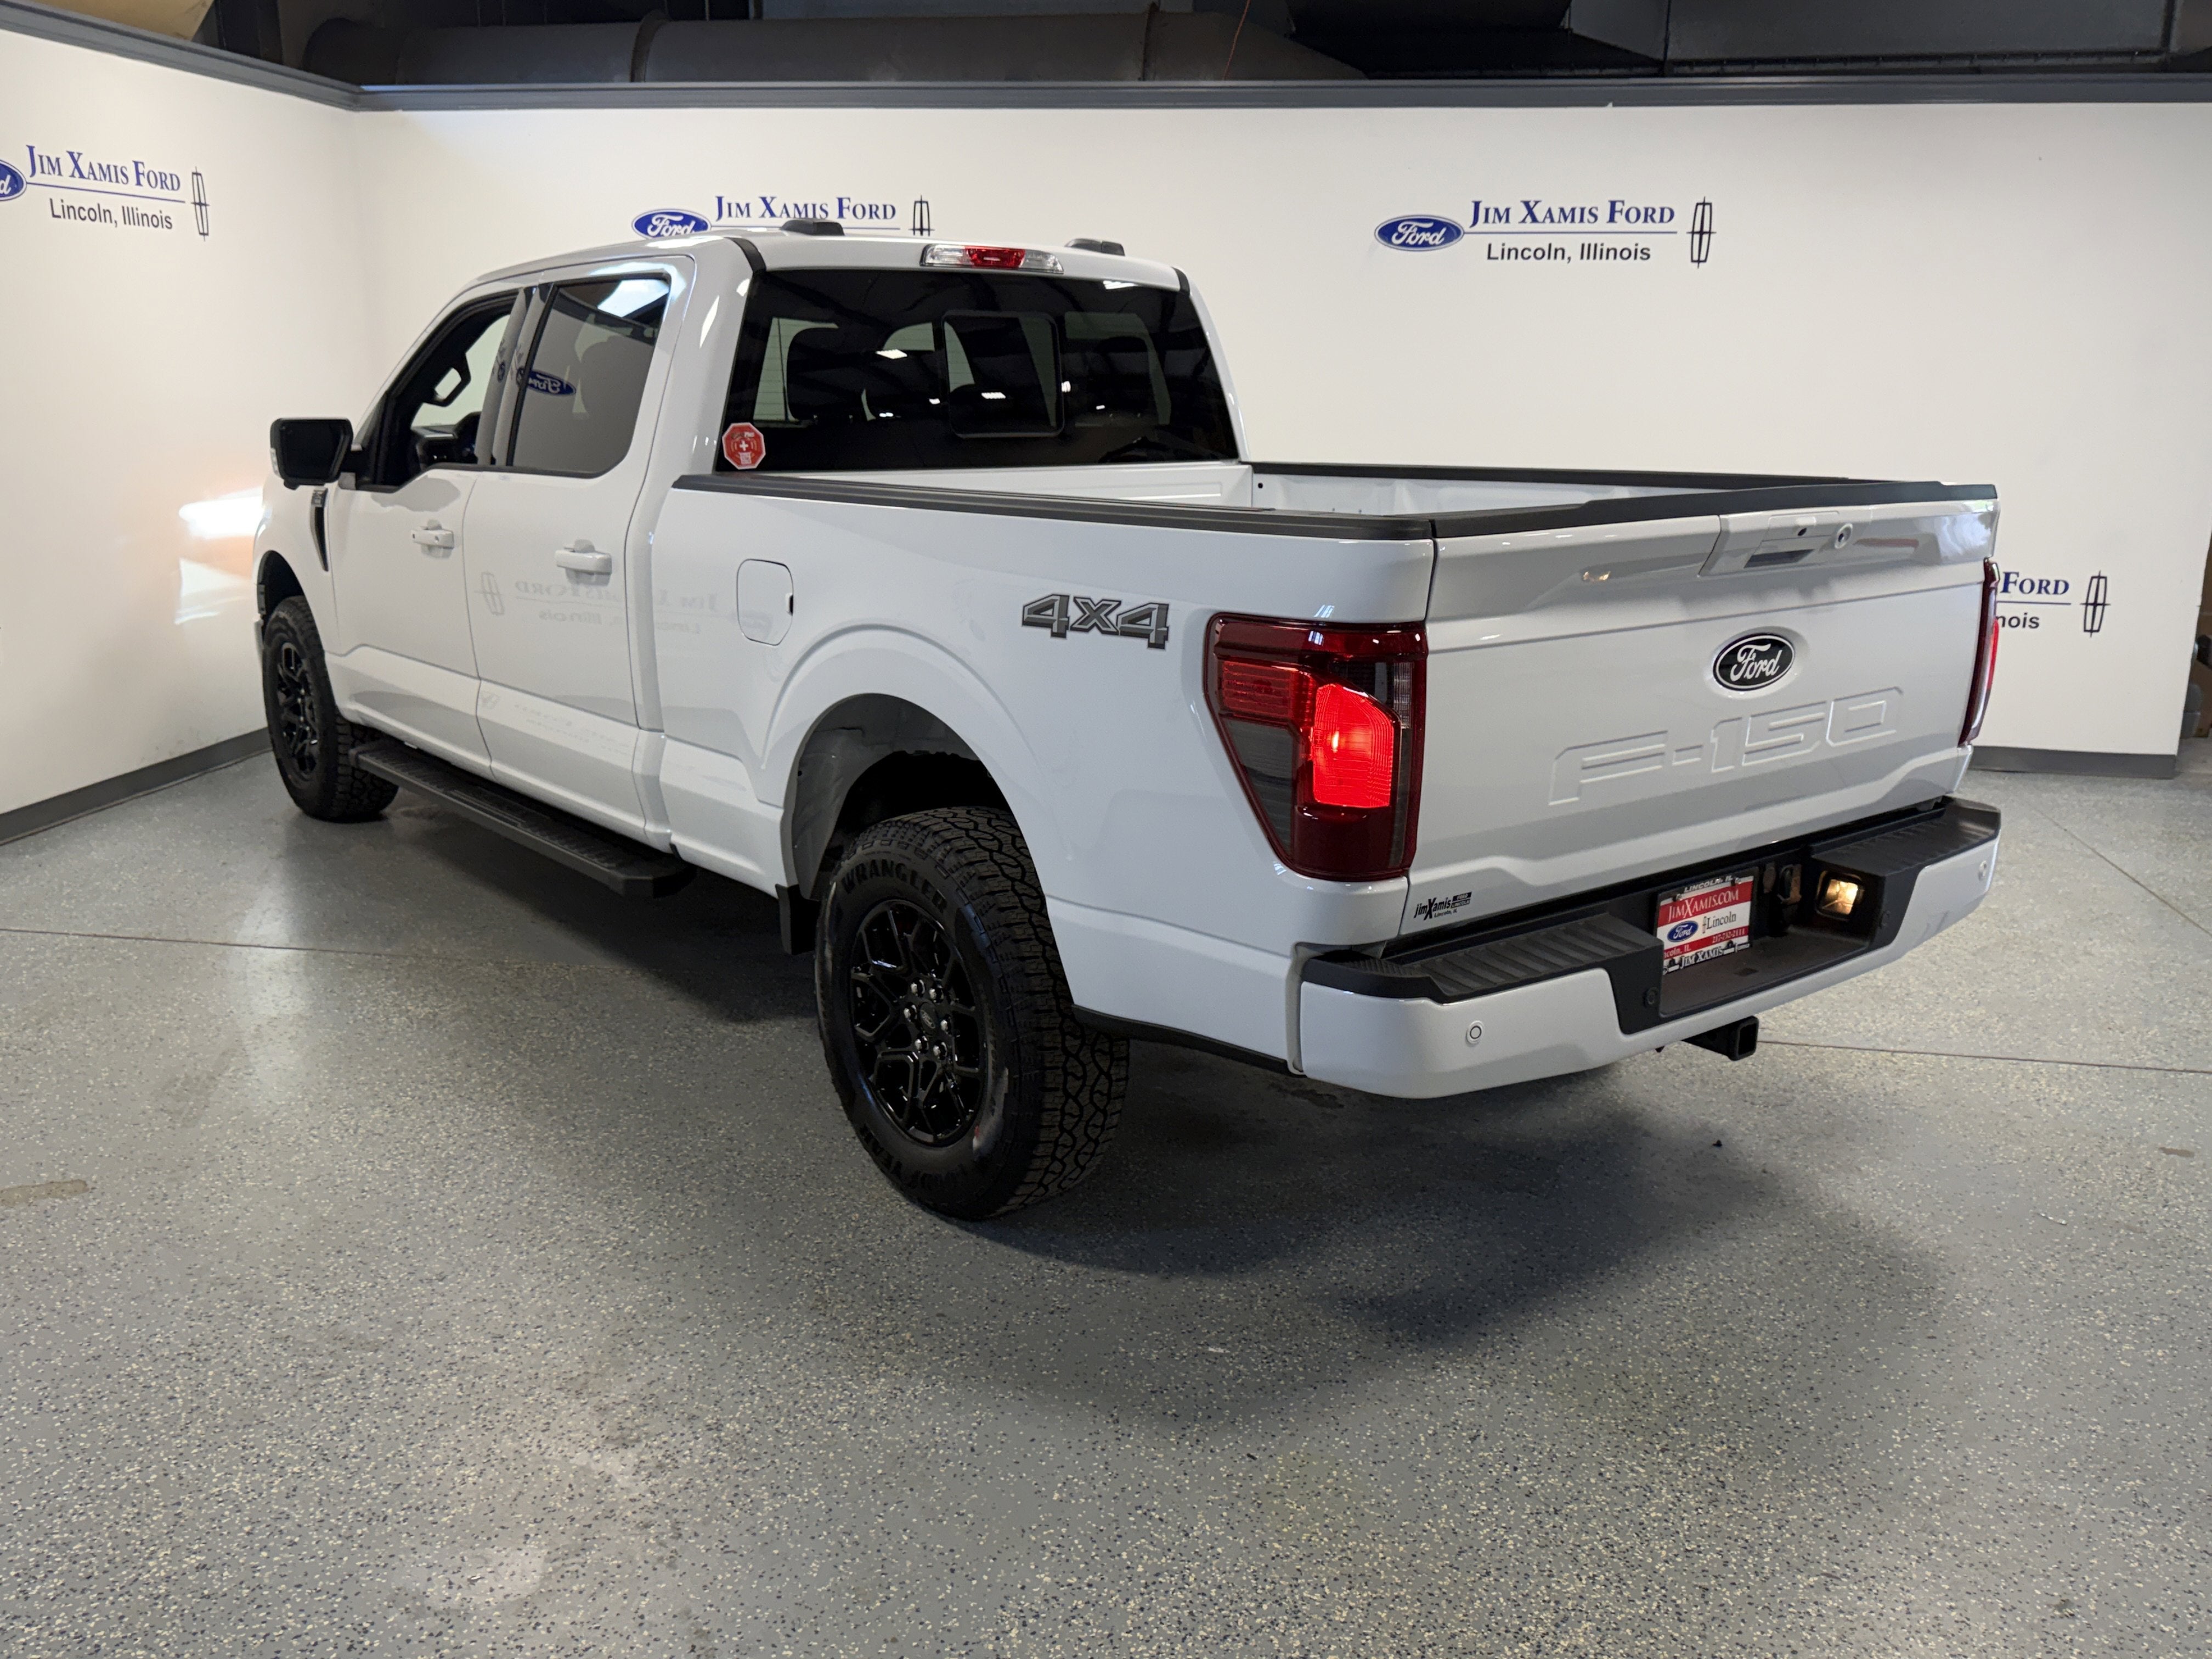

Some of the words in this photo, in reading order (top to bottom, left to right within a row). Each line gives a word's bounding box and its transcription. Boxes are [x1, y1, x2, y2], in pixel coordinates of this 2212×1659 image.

[26, 145, 63, 178] JIM
[66, 150, 129, 185] XAMIS
[132, 160, 180, 191] FORD
[49, 198, 117, 227] Lincoln,
[122, 206, 173, 229] Illinois
[715, 196, 751, 222] JIM
[758, 196, 829, 219] XAMIS
[836, 198, 896, 220] FORD
[1469, 200, 1511, 228] JIM
[1518, 200, 1599, 224] XAMIS
[1606, 200, 1675, 224] FORD
[647, 213, 695, 238] Ford
[1391, 221, 1445, 246] Ford
[1487, 242, 1572, 263] Lincoln,
[1579, 242, 1651, 261] Illinois
[2000, 571, 2070, 595] FORD
[1996, 612, 2040, 629] nois
[1730, 643, 1782, 682] Ford
[1548, 686, 1904, 805] F-150
[842, 859, 947, 913] WRANGLER
[1668, 888, 1739, 923] JIMXAMIS.COM
[1673, 924, 1692, 940] Ford
[1706, 911, 1736, 930] Lincoln
